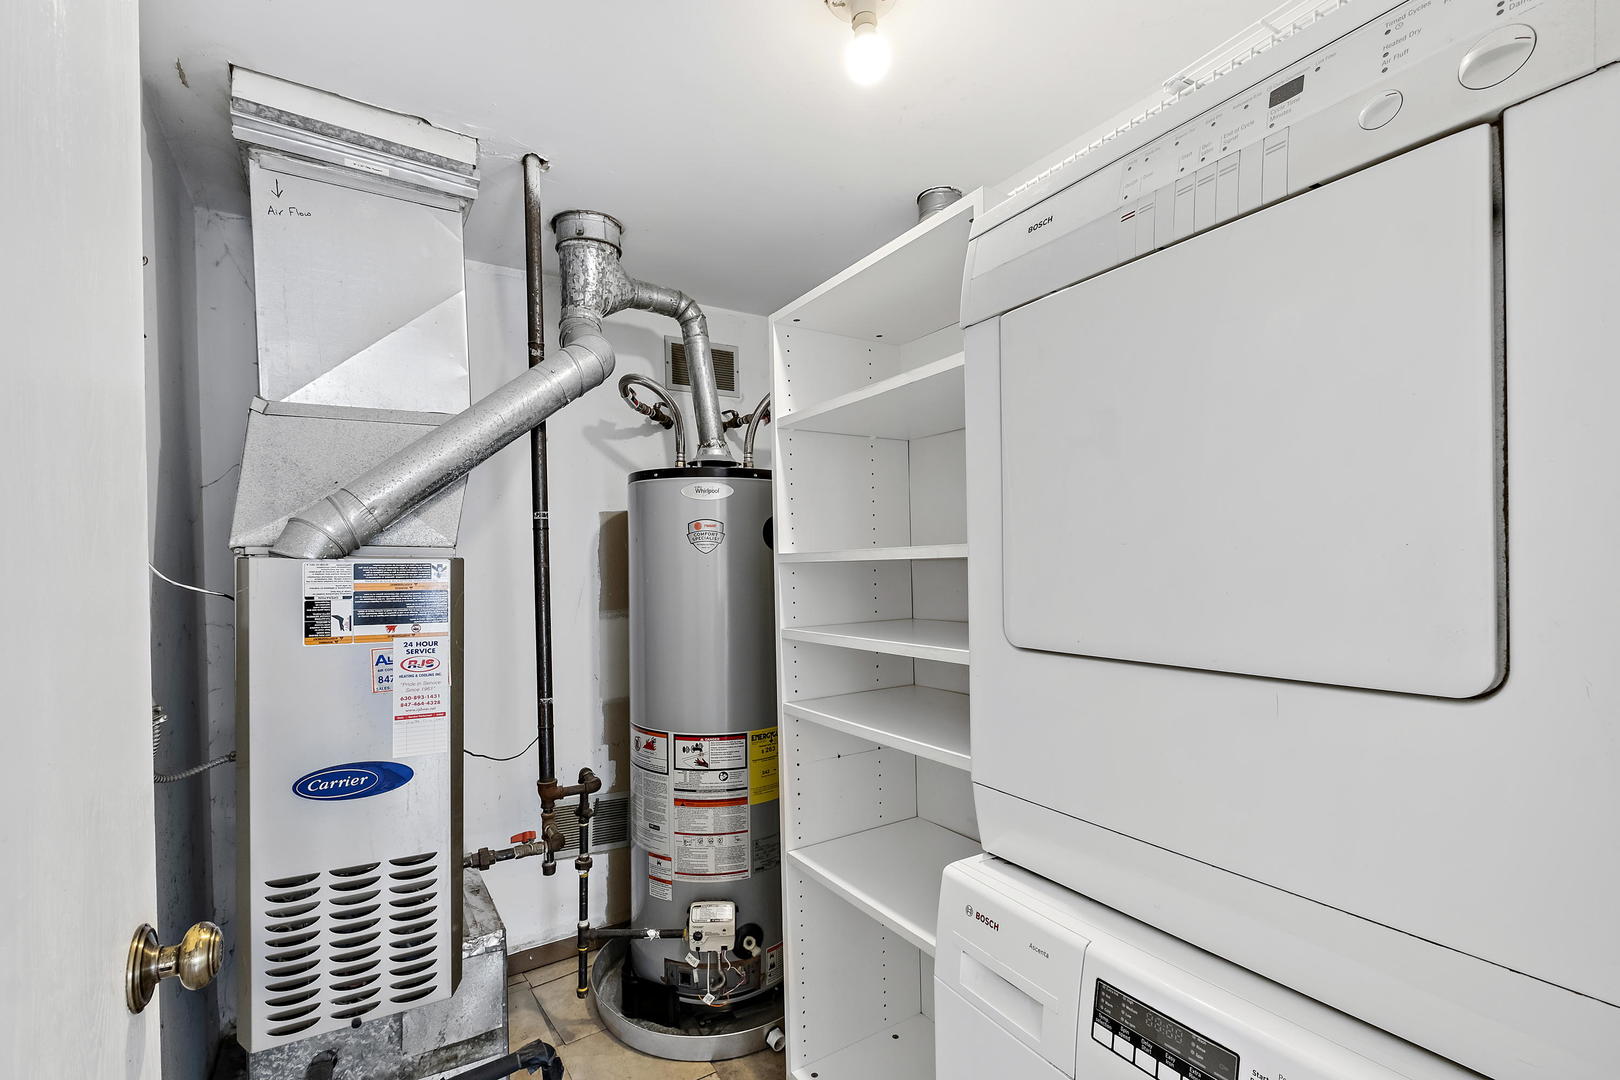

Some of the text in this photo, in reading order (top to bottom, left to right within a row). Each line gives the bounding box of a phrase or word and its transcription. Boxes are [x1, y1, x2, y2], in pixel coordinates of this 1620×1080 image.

[1385, 0, 1432, 28] Timed Cycles
[1382, 27, 1422, 51] Heated Dry
[1381, 58, 1391, 67] Air
[267, 205, 312, 217] Air Flow
[1028, 216, 1053, 233] BOSCH
[694, 486, 720, 495] Whirlpool
[415, 640, 439, 648] HOUR
[407, 659, 435, 669] RJS
[307, 776, 369, 791] Carrier
[975, 911, 1000, 932] BOSCH
[1028, 943, 1049, 959] Ascenta
